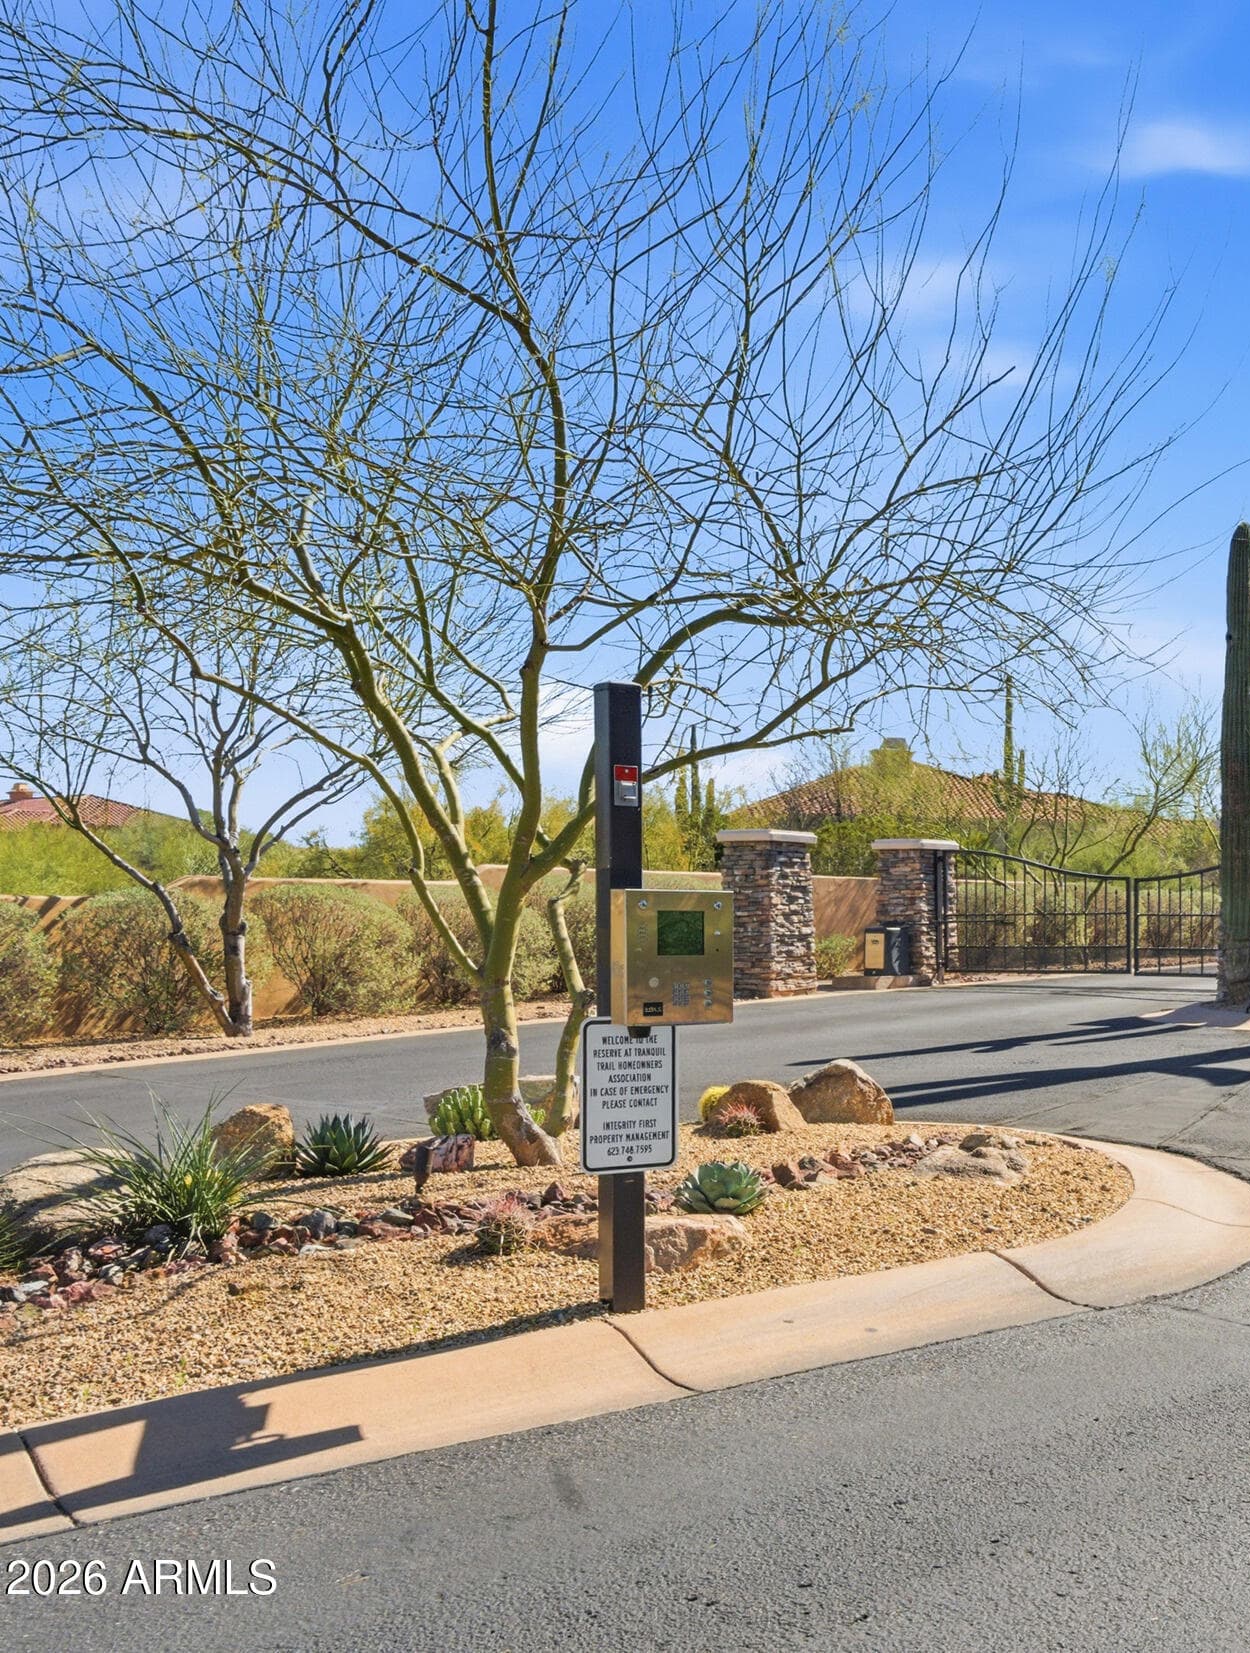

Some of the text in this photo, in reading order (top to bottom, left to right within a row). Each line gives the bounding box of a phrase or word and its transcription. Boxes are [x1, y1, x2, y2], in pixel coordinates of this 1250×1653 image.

[602, 1035, 633, 1045] WELCOME
[593, 1047, 666, 1058] RESERVE AT TRANQUIL
[597, 1060, 663, 1071] TRAIL HOMEOWNERS
[608, 1073, 652, 1083] ASSOCIATION
[590, 1084, 669, 1097] IN CASE OF EMERGENCY
[602, 1098, 658, 1109] PLEASE CONTACT
[603, 1119, 657, 1130] INTEGRITY FIRST
[589, 1131, 669, 1144] PROPERTY MANAGEMENT
